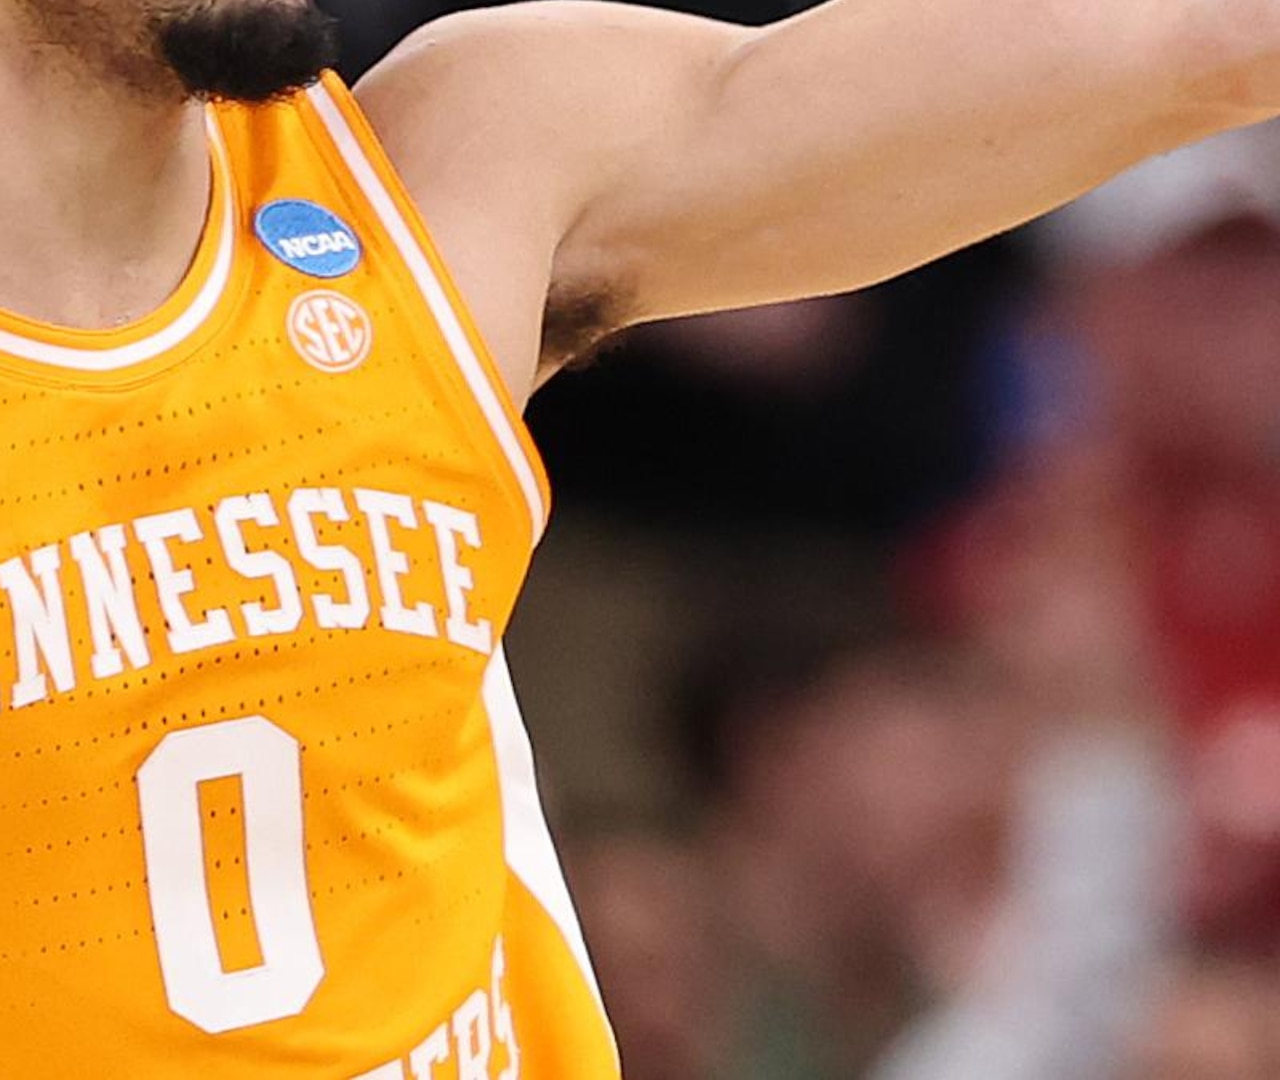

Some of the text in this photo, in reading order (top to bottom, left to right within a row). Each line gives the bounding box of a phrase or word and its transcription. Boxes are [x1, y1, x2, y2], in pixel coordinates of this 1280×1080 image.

[278, 231, 355, 258] NCAA
[294, 298, 363, 362] SEC
[137, 715, 326, 1035] 0
